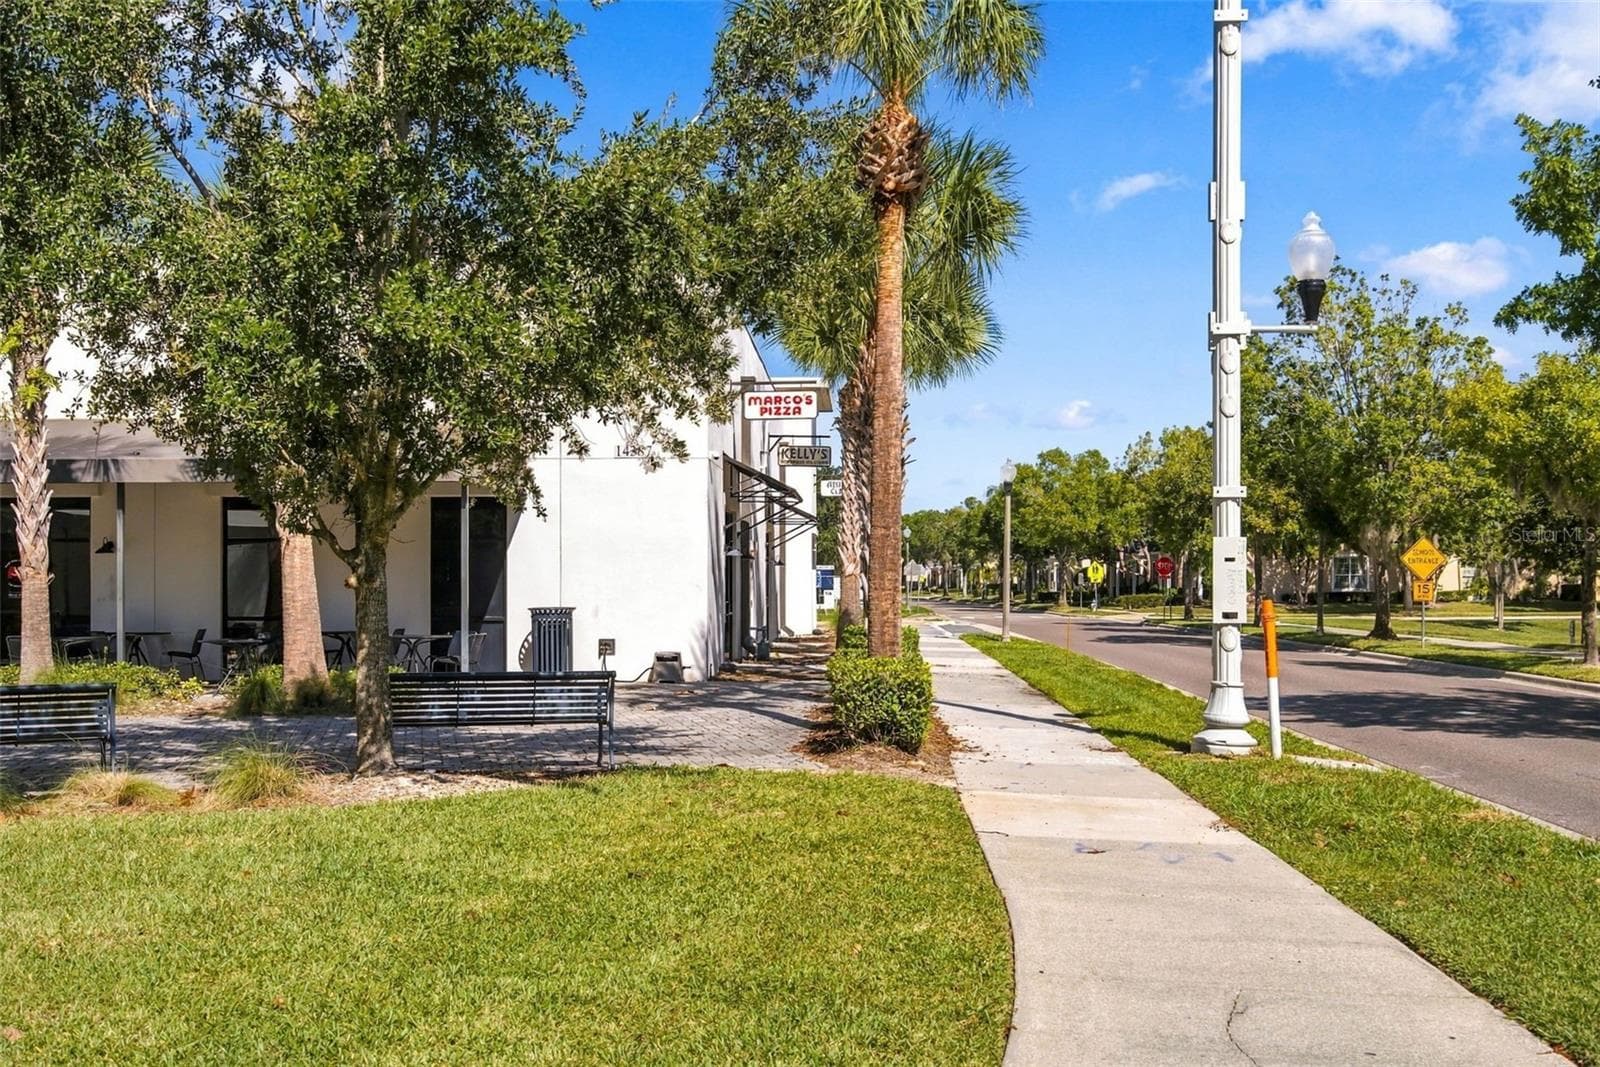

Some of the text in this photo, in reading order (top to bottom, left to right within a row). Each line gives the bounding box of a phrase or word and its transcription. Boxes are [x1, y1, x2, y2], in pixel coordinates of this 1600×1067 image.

[748, 395, 813, 406] MARCO'S
[760, 406, 801, 416] PIZZA
[781, 448, 828, 460] KELLY'S
[1157, 561, 1173, 570] STOP
[1417, 584, 1430, 594] 15
